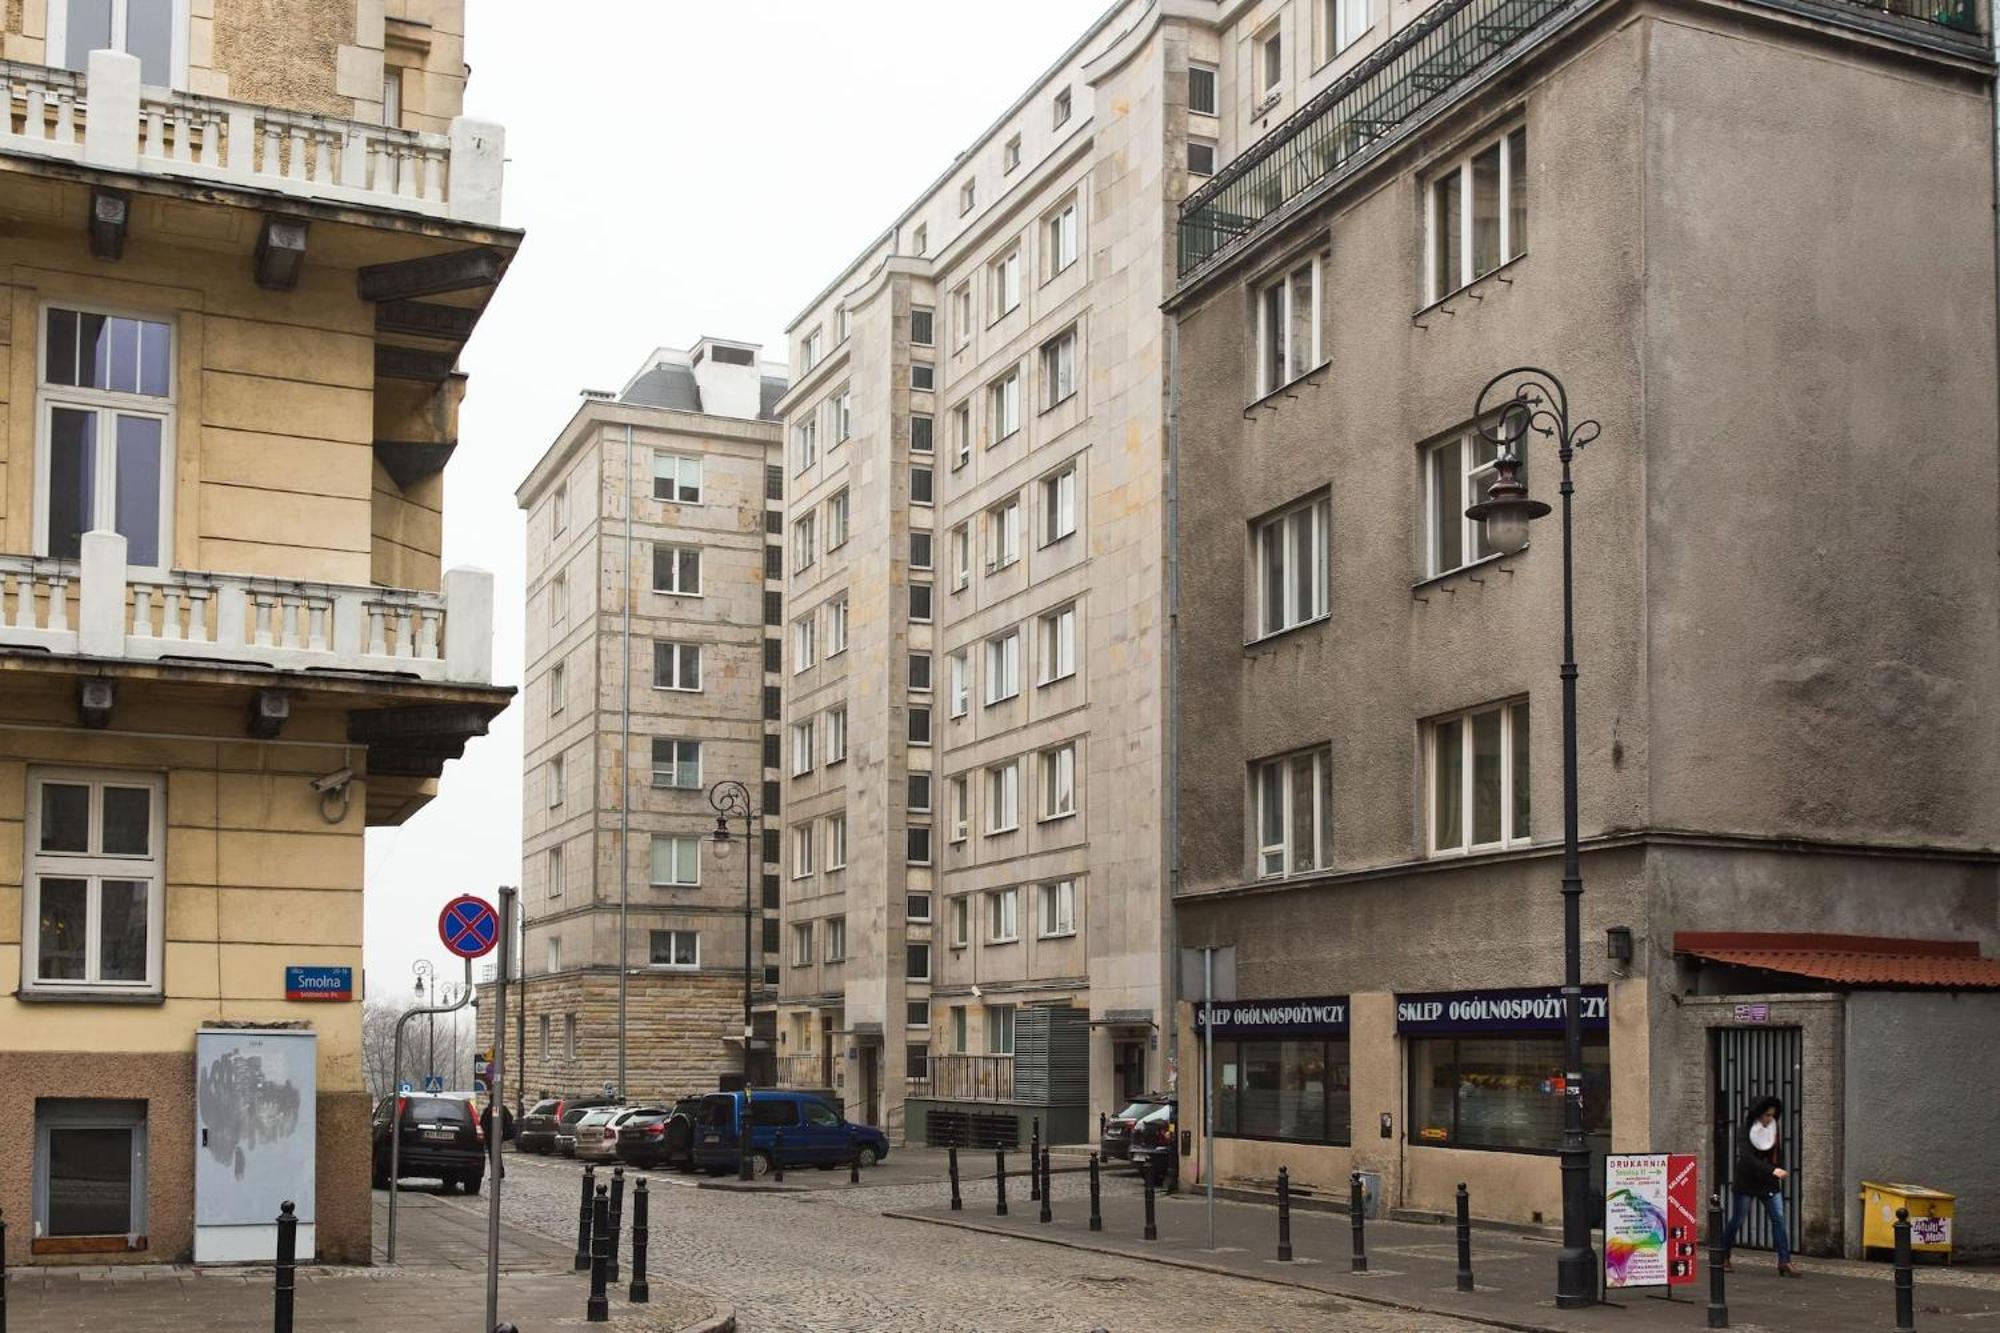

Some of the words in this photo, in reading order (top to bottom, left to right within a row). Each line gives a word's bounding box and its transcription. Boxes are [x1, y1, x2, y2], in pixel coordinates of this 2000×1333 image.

[298, 975, 341, 988] Smolna
[1198, 1008, 1230, 1025] SLEP
[1234, 1002, 1345, 1025] OGÓLNOSPOŻYWCZY
[1398, 1002, 1442, 1021] SKLEP
[1610, 1160, 1666, 1168] DRUKARNIA
